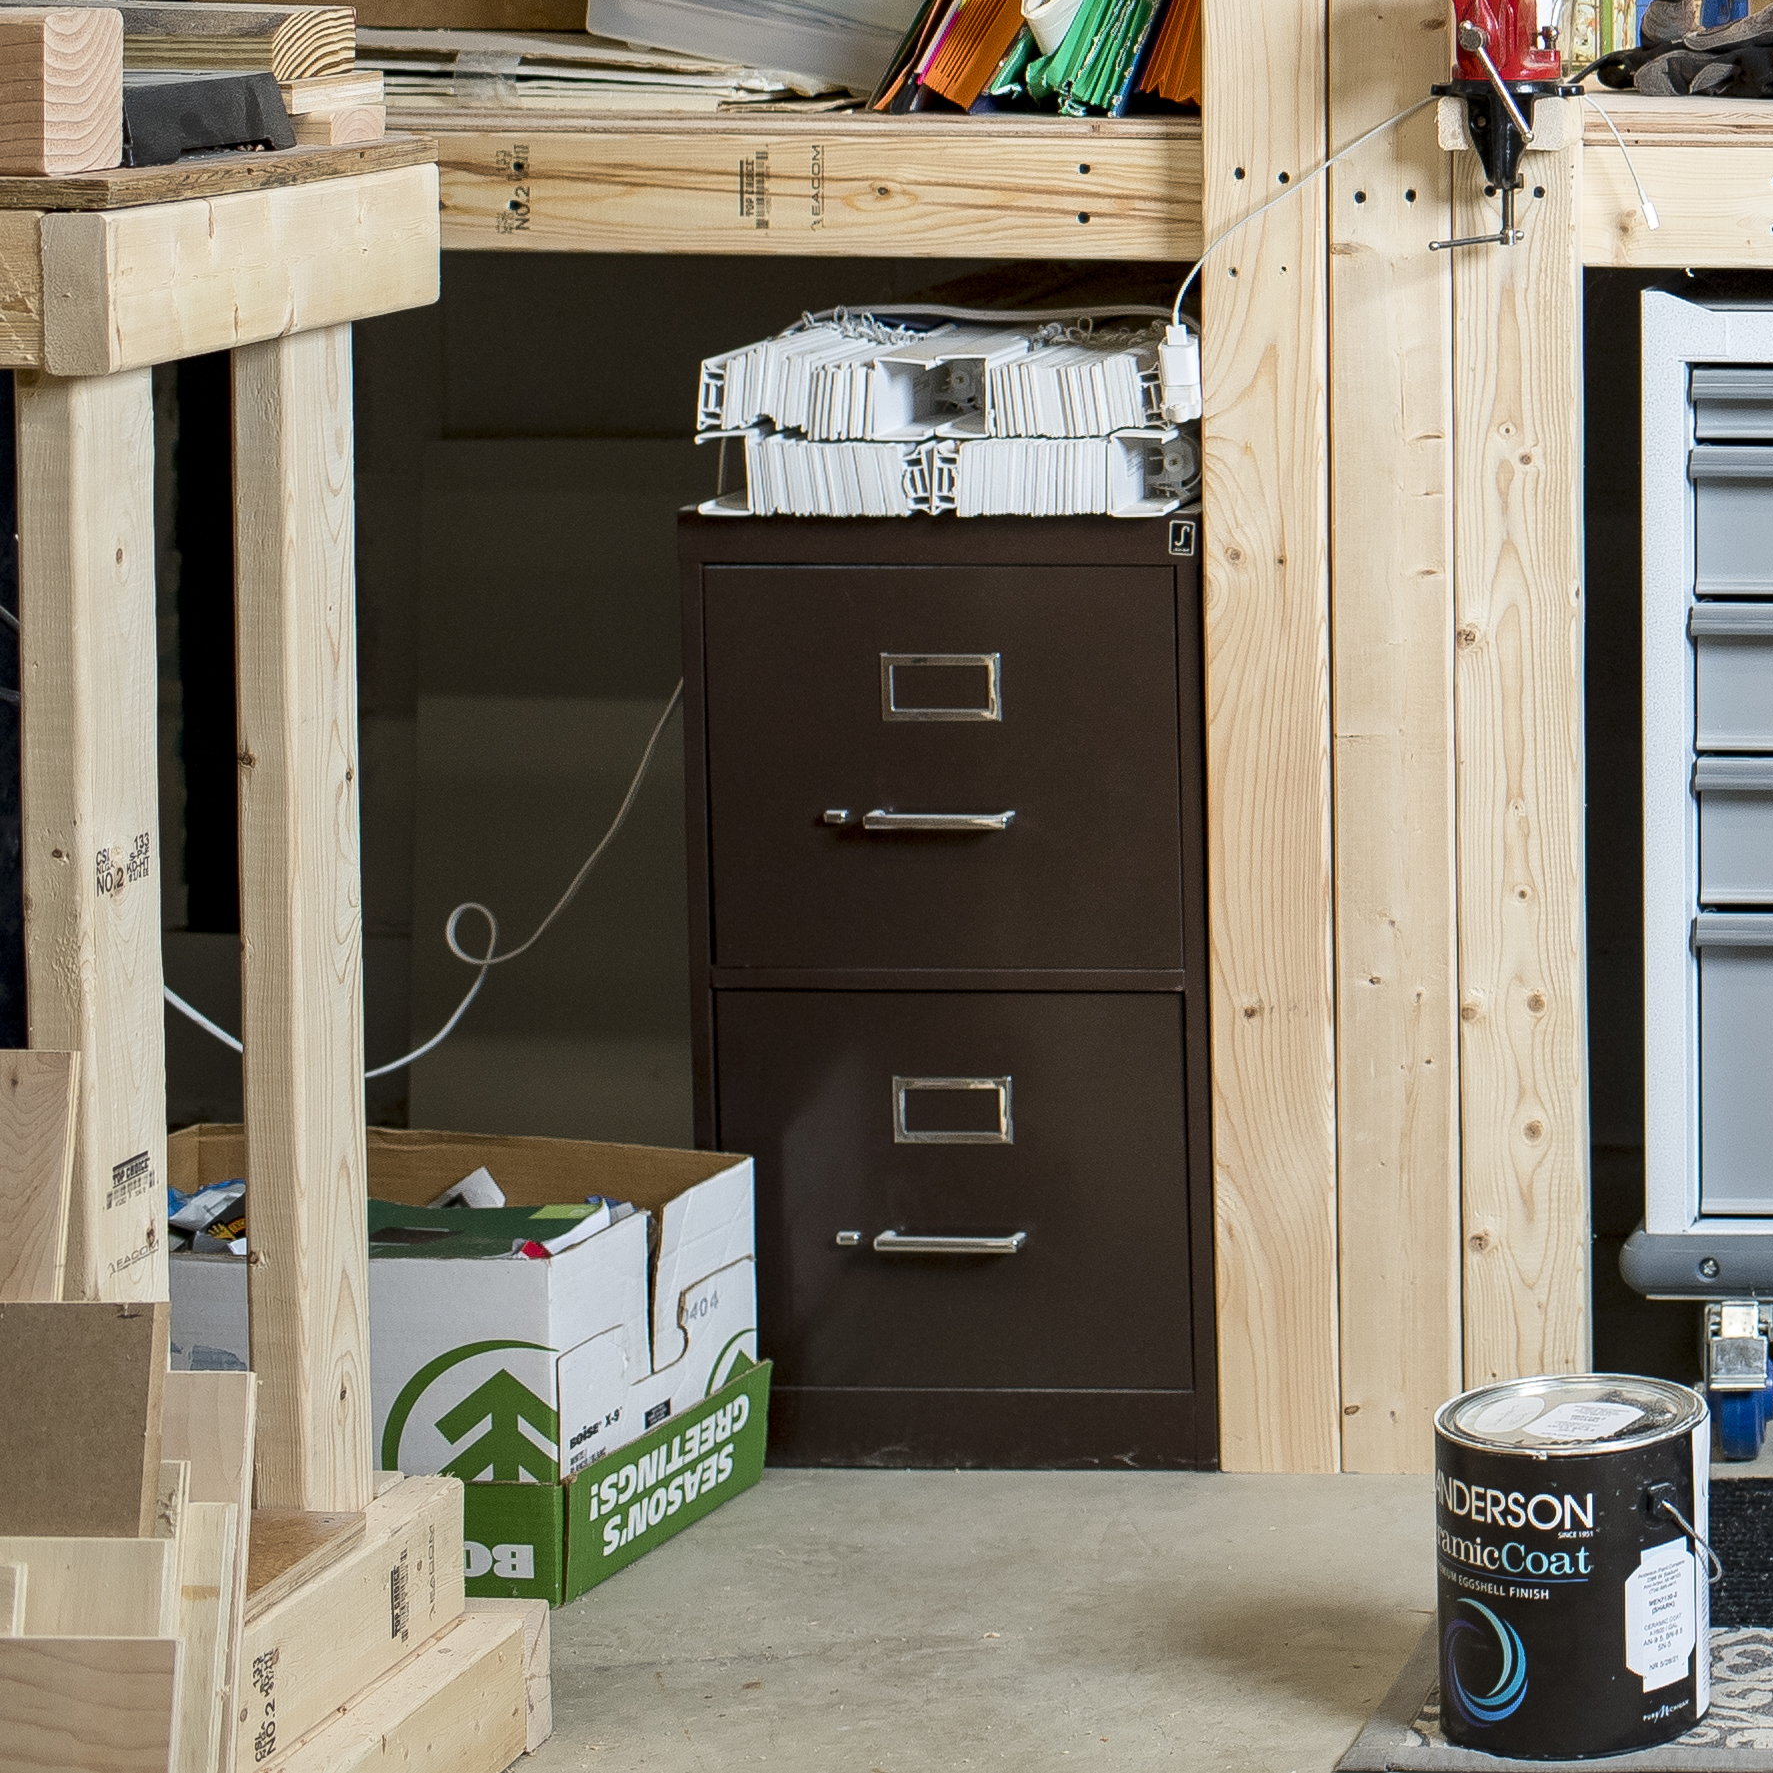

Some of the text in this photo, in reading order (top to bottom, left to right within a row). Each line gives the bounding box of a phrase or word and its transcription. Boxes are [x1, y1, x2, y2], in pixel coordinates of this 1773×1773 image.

[811, 145, 820, 216] EACOM
[134, 832, 150, 850] 133
[97, 867, 124, 898] NO.2
[113, 1170, 125, 1186] TOP
[589, 1394, 750, 1522] GREETINGS!
[603, 1442, 735, 1557] SEASON'S
[1578, 1530, 1594, 1539] 1951
[1459, 1574, 1550, 1600] EGGSHELL FINISH
[264, 1698, 276, 1756] NO.2
